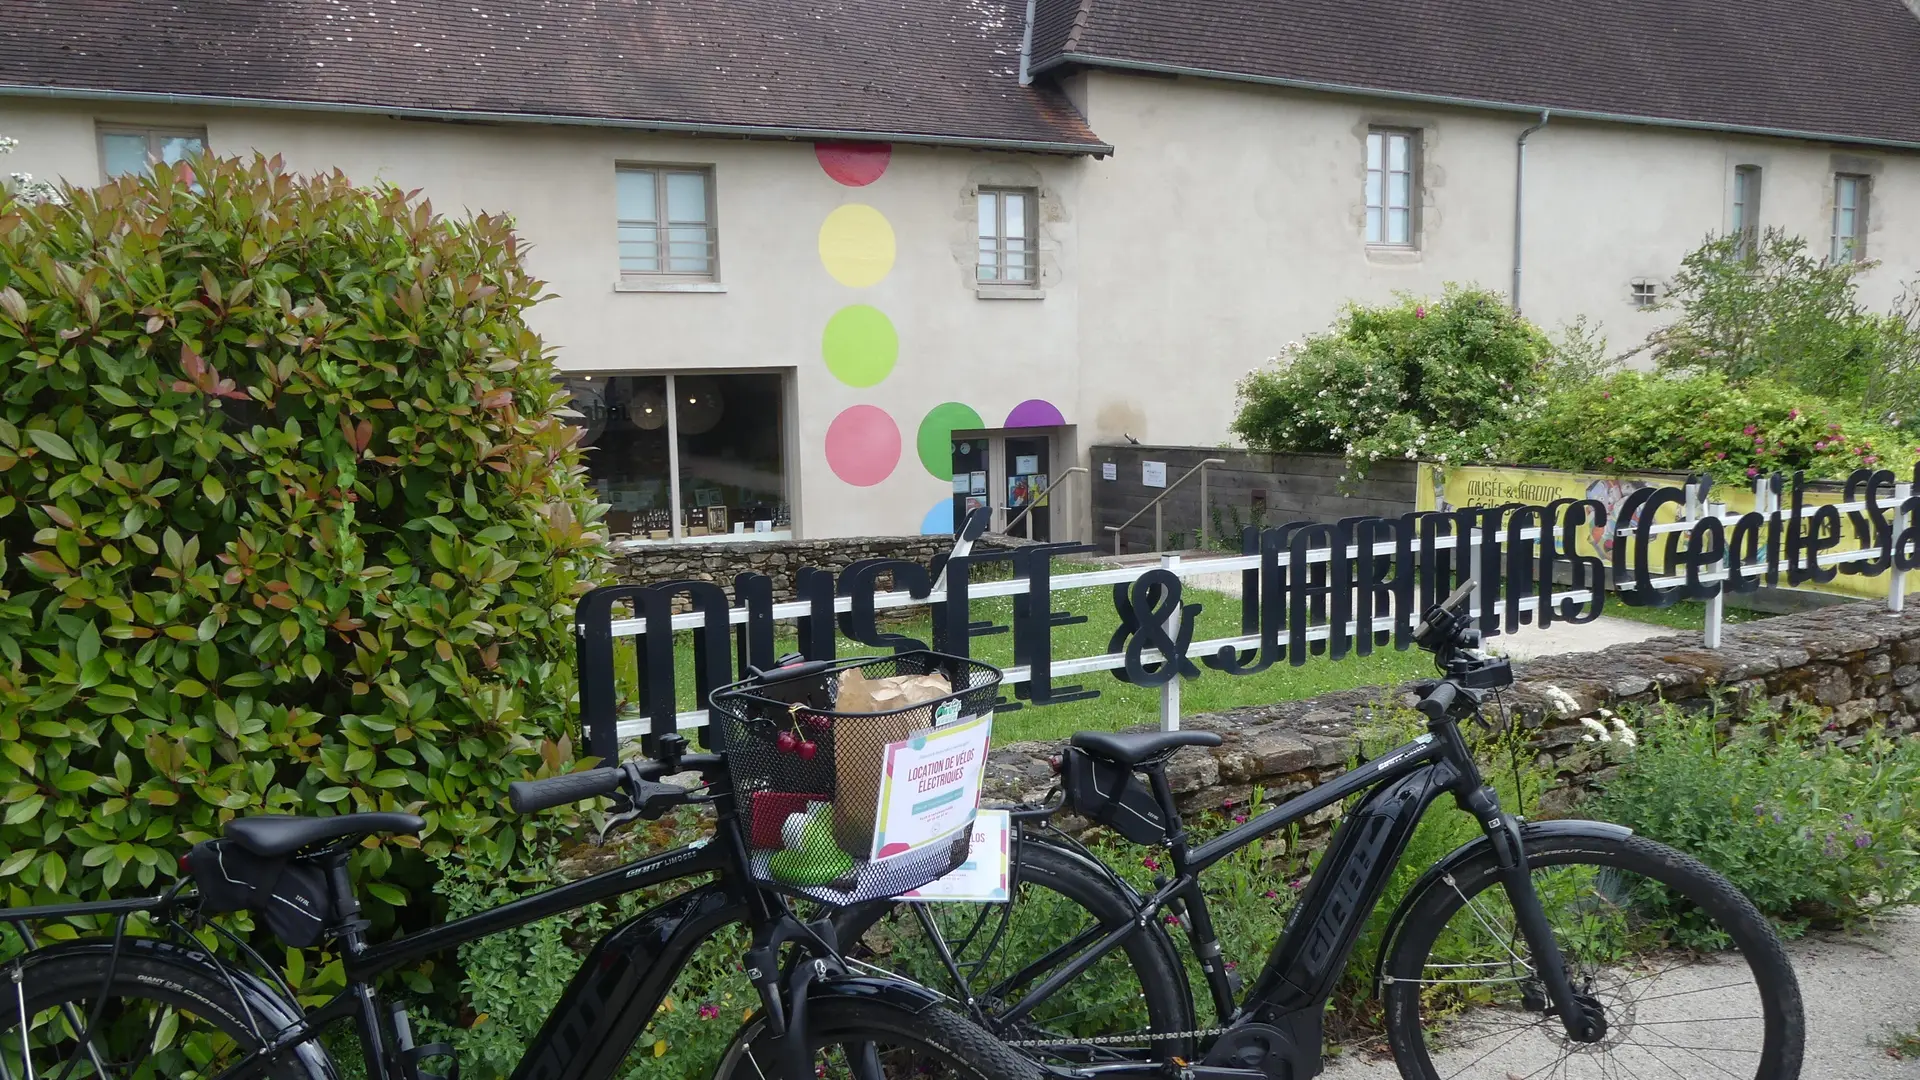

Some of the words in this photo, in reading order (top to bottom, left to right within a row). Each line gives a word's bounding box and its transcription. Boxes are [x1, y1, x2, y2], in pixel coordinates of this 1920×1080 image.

[1467, 477, 1504, 498] MUSÉE
[1505, 486, 1514, 498] &
[1515, 479, 1563, 502] JARDINS
[1110, 569, 1203, 688] &
[1213, 498, 1607, 676] JARDINS
[1614, 471, 1842, 608] Cécile
[908, 759, 944, 782] LOCATION
[944, 756, 955, 770] DE
[955, 748, 975, 767] VÉLOS
[918, 767, 964, 793] ÉLECTRIQUES
[664, 851, 698, 866] LIMOGES
[183, 988, 249, 1030] CROSSCUT
